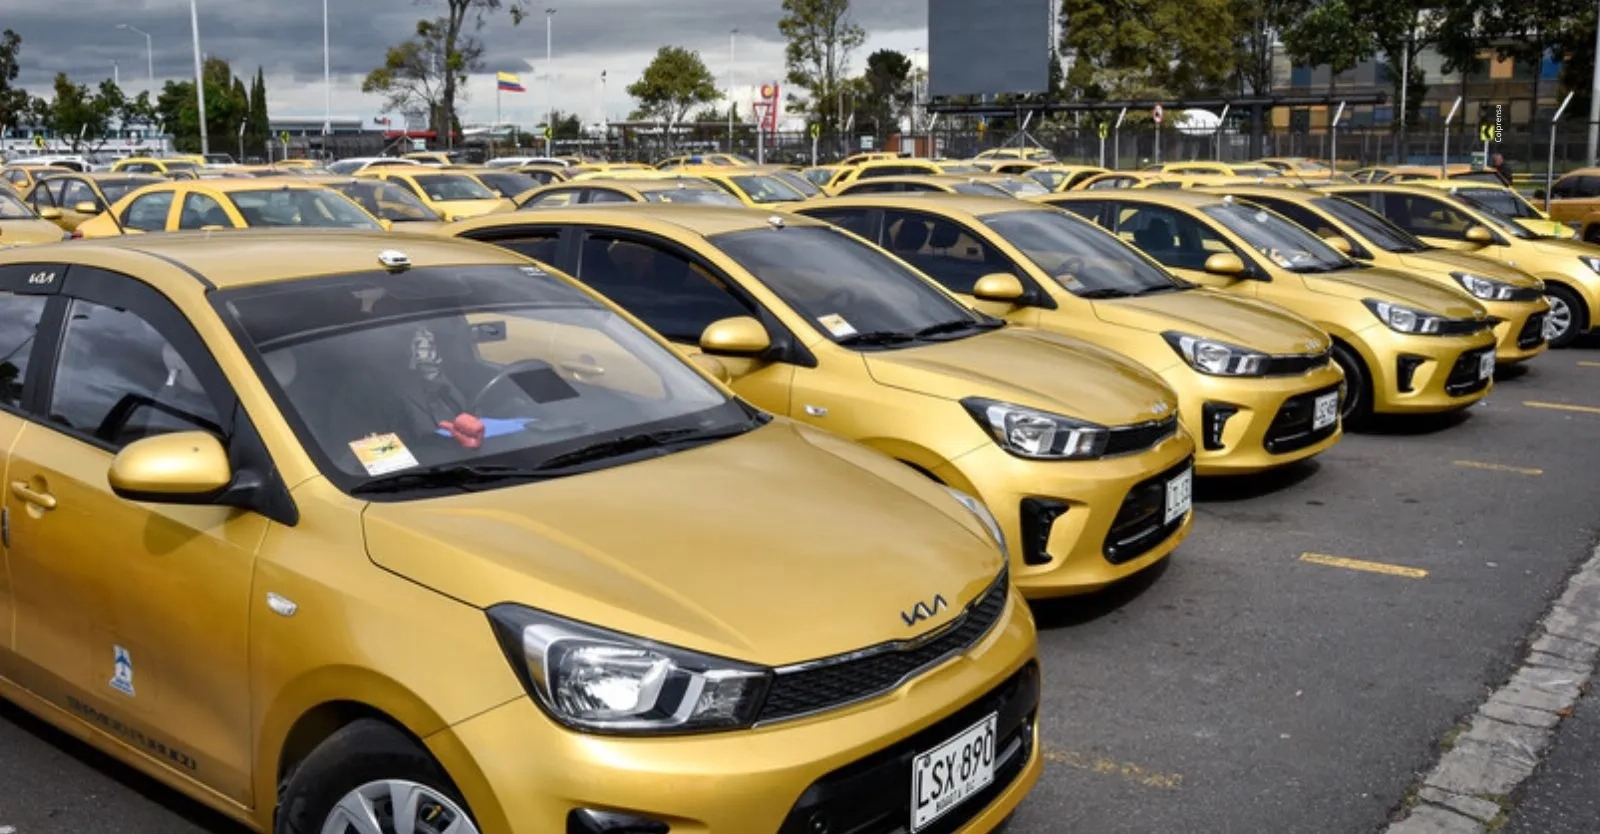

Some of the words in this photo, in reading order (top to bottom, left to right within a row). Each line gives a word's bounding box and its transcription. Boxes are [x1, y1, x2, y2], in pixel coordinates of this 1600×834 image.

[901, 594, 947, 627] KIA
[917, 751, 957, 810] LSX
[960, 729, 993, 781] 890
